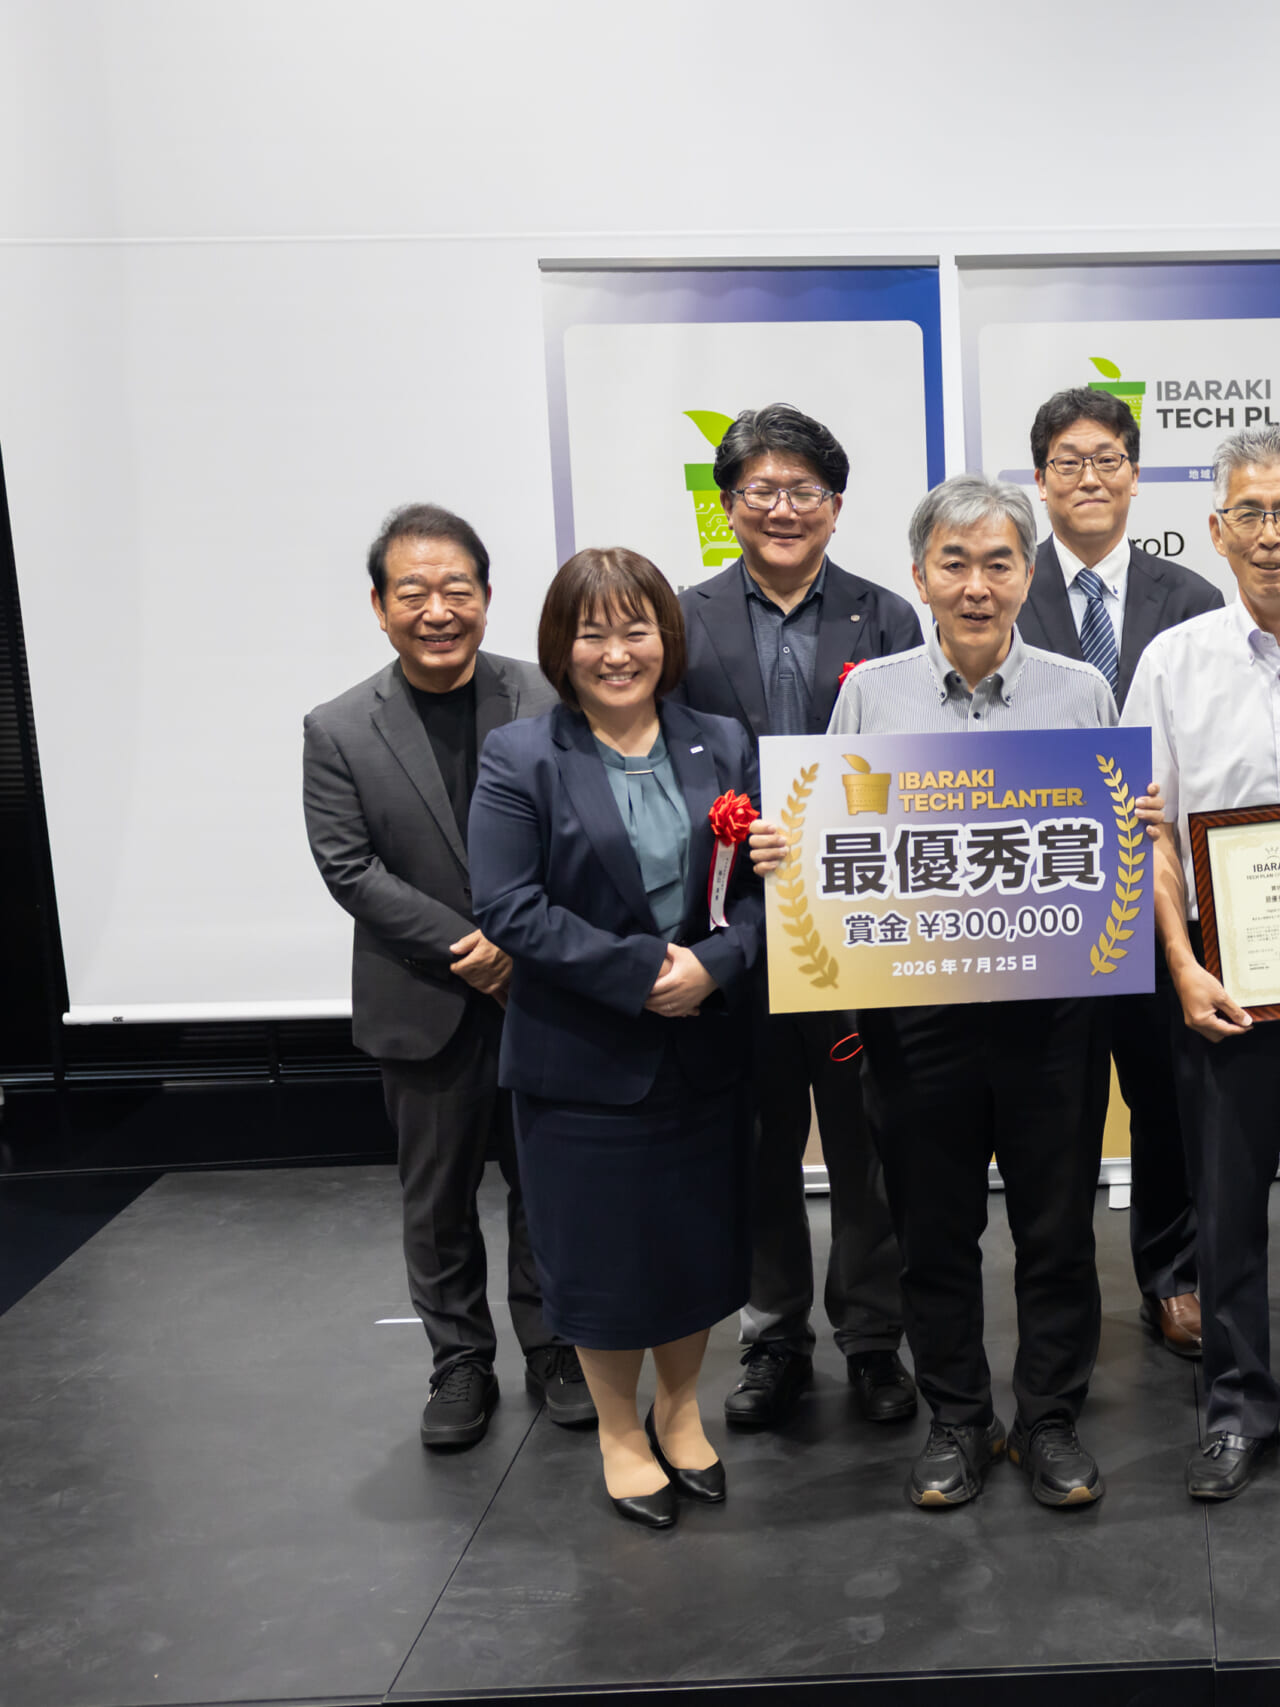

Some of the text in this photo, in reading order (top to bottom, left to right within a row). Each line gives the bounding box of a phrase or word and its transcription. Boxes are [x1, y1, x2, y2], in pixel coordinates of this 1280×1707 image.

[1156, 379, 1271, 401] IBARAKI
[1156, 408, 1234, 428] TECH
[1188, 469, 1215, 480] 地域
[899, 769, 995, 790] IBARAKI
[899, 788, 1084, 812] TECH PLANTER
[821, 823, 1101, 896] 最優秀賞
[845, 906, 1082, 946] 賞金 ¥300,000
[892, 955, 1037, 977] 2026年7月25日
